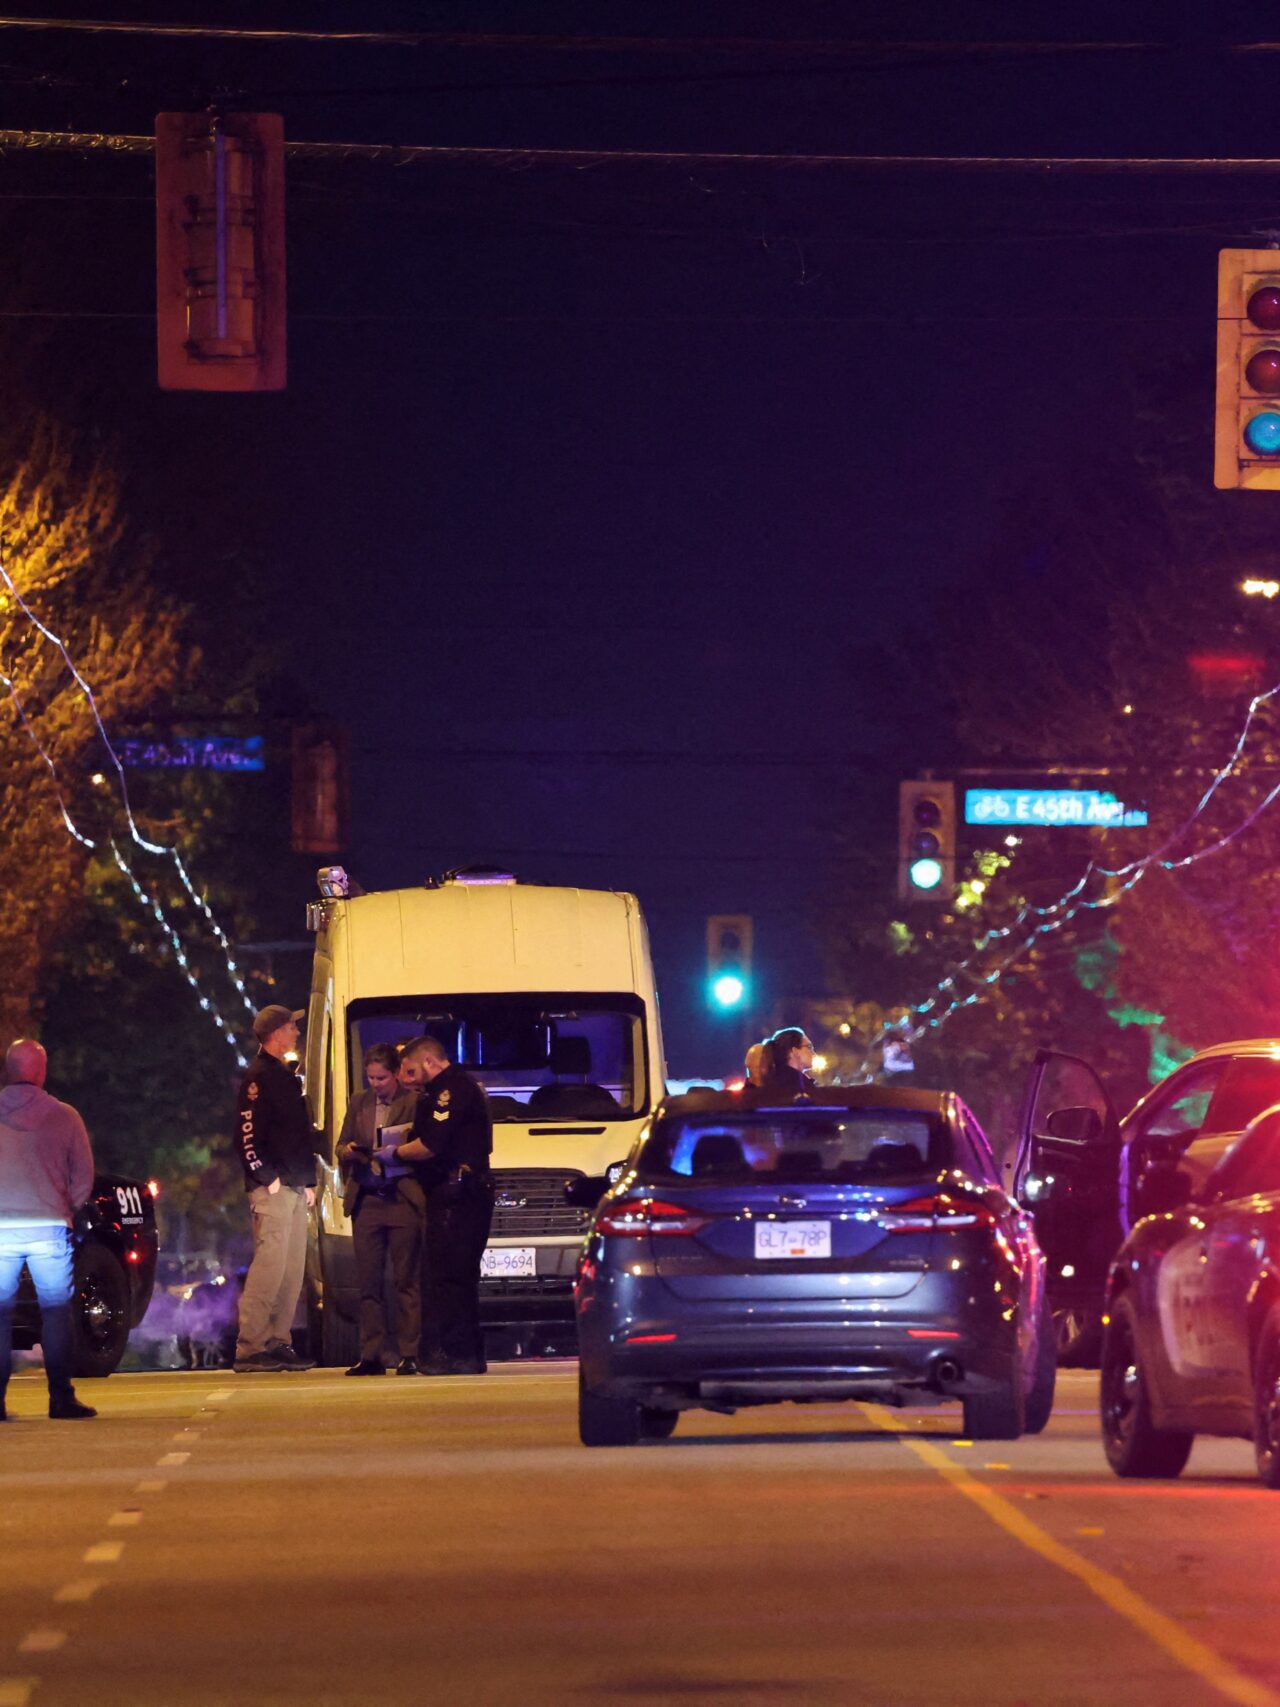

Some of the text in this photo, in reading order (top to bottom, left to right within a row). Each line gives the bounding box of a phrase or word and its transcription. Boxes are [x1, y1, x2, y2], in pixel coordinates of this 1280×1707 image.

[1016, 796, 1030, 819] E
[1033, 796, 1083, 821] 45th
[241, 1110, 263, 1171] POLICE
[116, 1186, 142, 1215] 911
